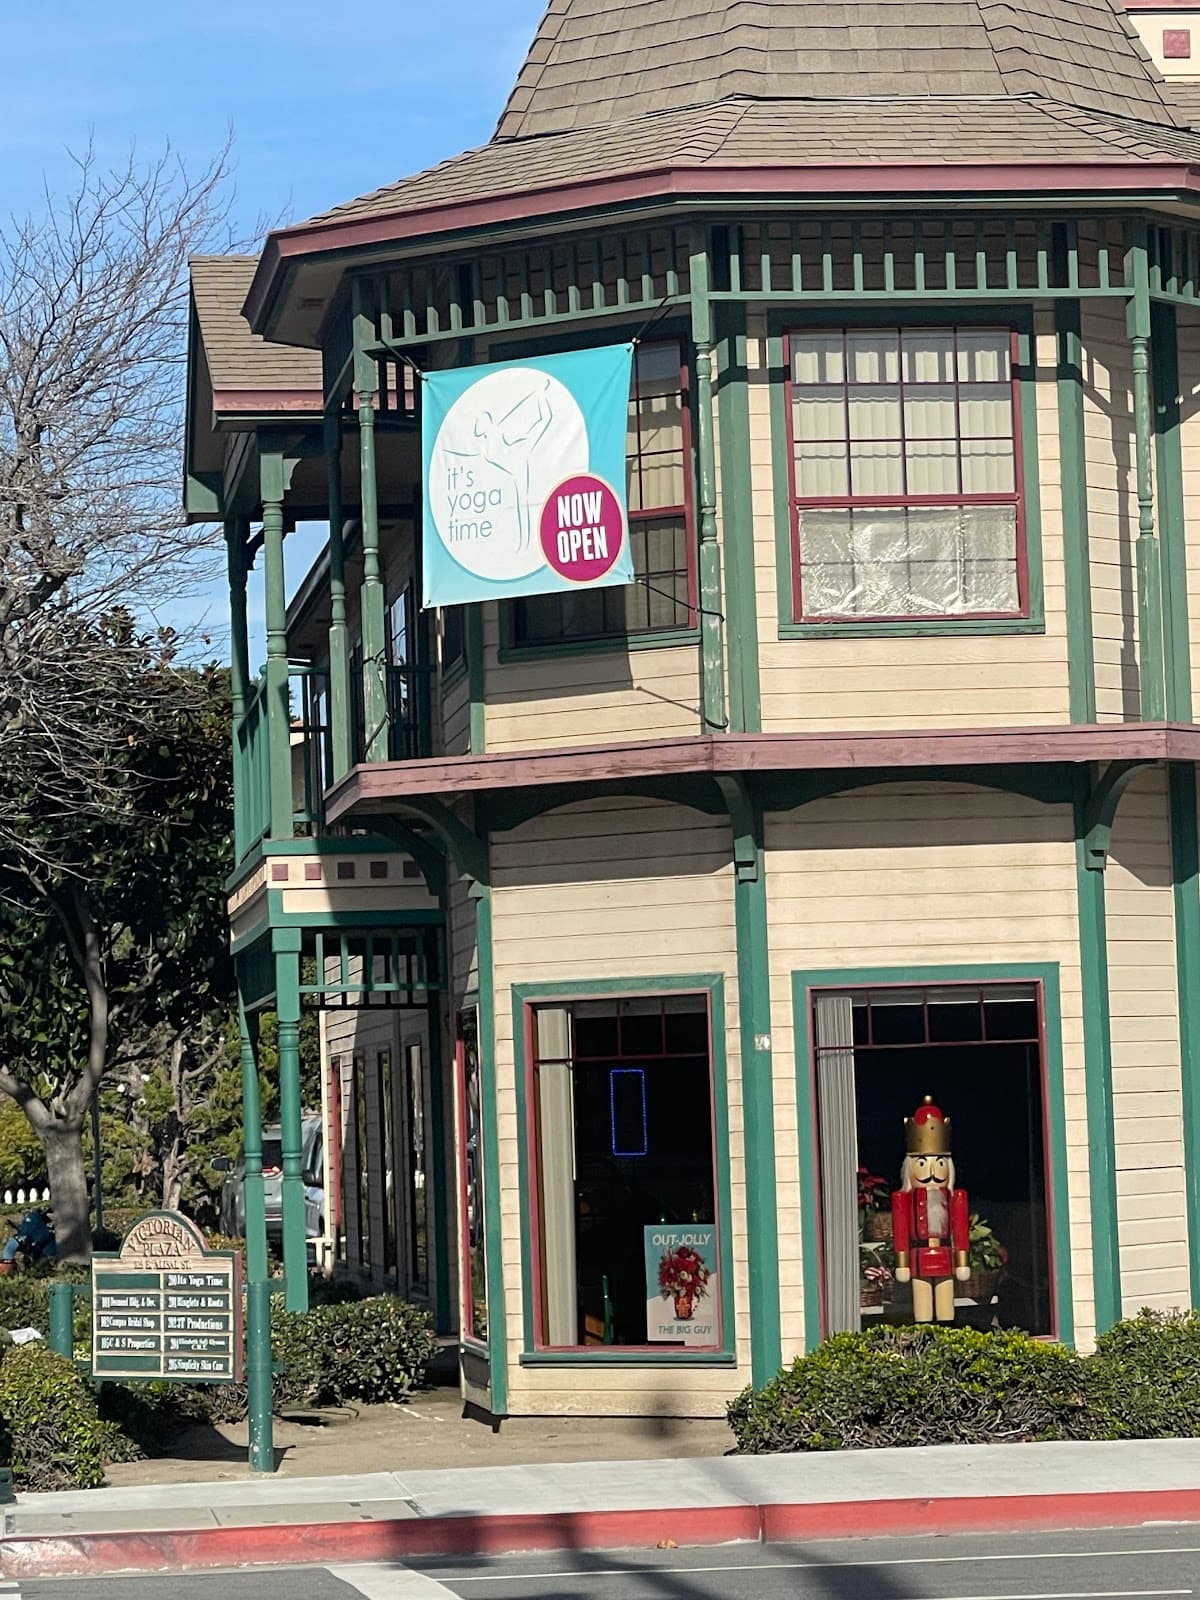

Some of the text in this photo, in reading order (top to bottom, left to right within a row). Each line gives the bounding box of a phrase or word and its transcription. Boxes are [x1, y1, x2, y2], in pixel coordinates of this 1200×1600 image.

[447, 465, 474, 491] it's
[447, 488, 502, 518] yoga
[557, 490, 603, 529] NOW
[448, 519, 493, 544] time
[556, 525, 608, 565] OPEN
[126, 1219, 196, 1252] VICTORIAN
[652, 1233, 711, 1246] OUT-JOLLY
[142, 1242, 183, 1257] PLAZA
[154, 1260, 180, 1270] ALISAL
[188, 1274, 205, 1287] Yoga
[206, 1275, 224, 1287] Time
[200, 1296, 207, 1307] &
[142, 1317, 156, 1329] Shop
[186, 1317, 223, 1330] Productions
[659, 1325, 712, 1334] THE BIG GUY
[114, 1338, 121, 1348] &
[120, 1337, 126, 1348] S
[127, 1338, 156, 1350] Properties
[200, 1360, 212, 1370] Skin
[212, 1360, 224, 1371] Care
